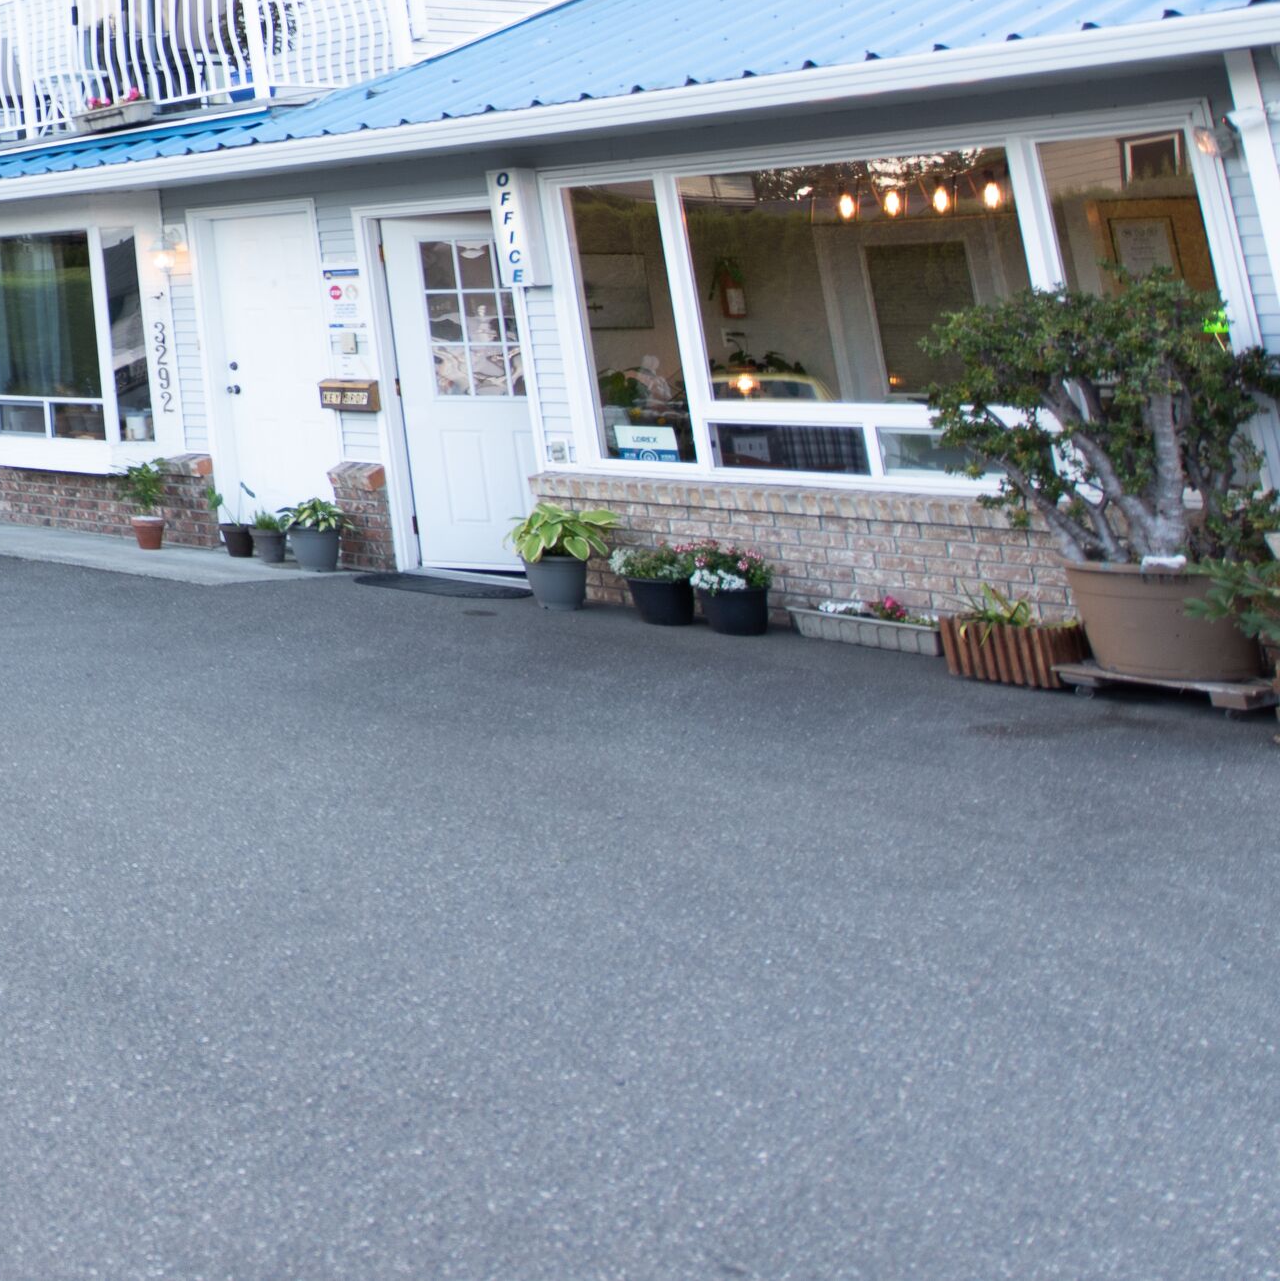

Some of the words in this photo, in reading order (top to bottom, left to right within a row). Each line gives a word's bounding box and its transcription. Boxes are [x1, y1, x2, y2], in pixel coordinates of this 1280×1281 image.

[496, 172, 524, 284] OFFICE
[154, 321, 175, 413] 3292
[323, 392, 341, 405] KEY
[342, 392, 368, 405] DROP
